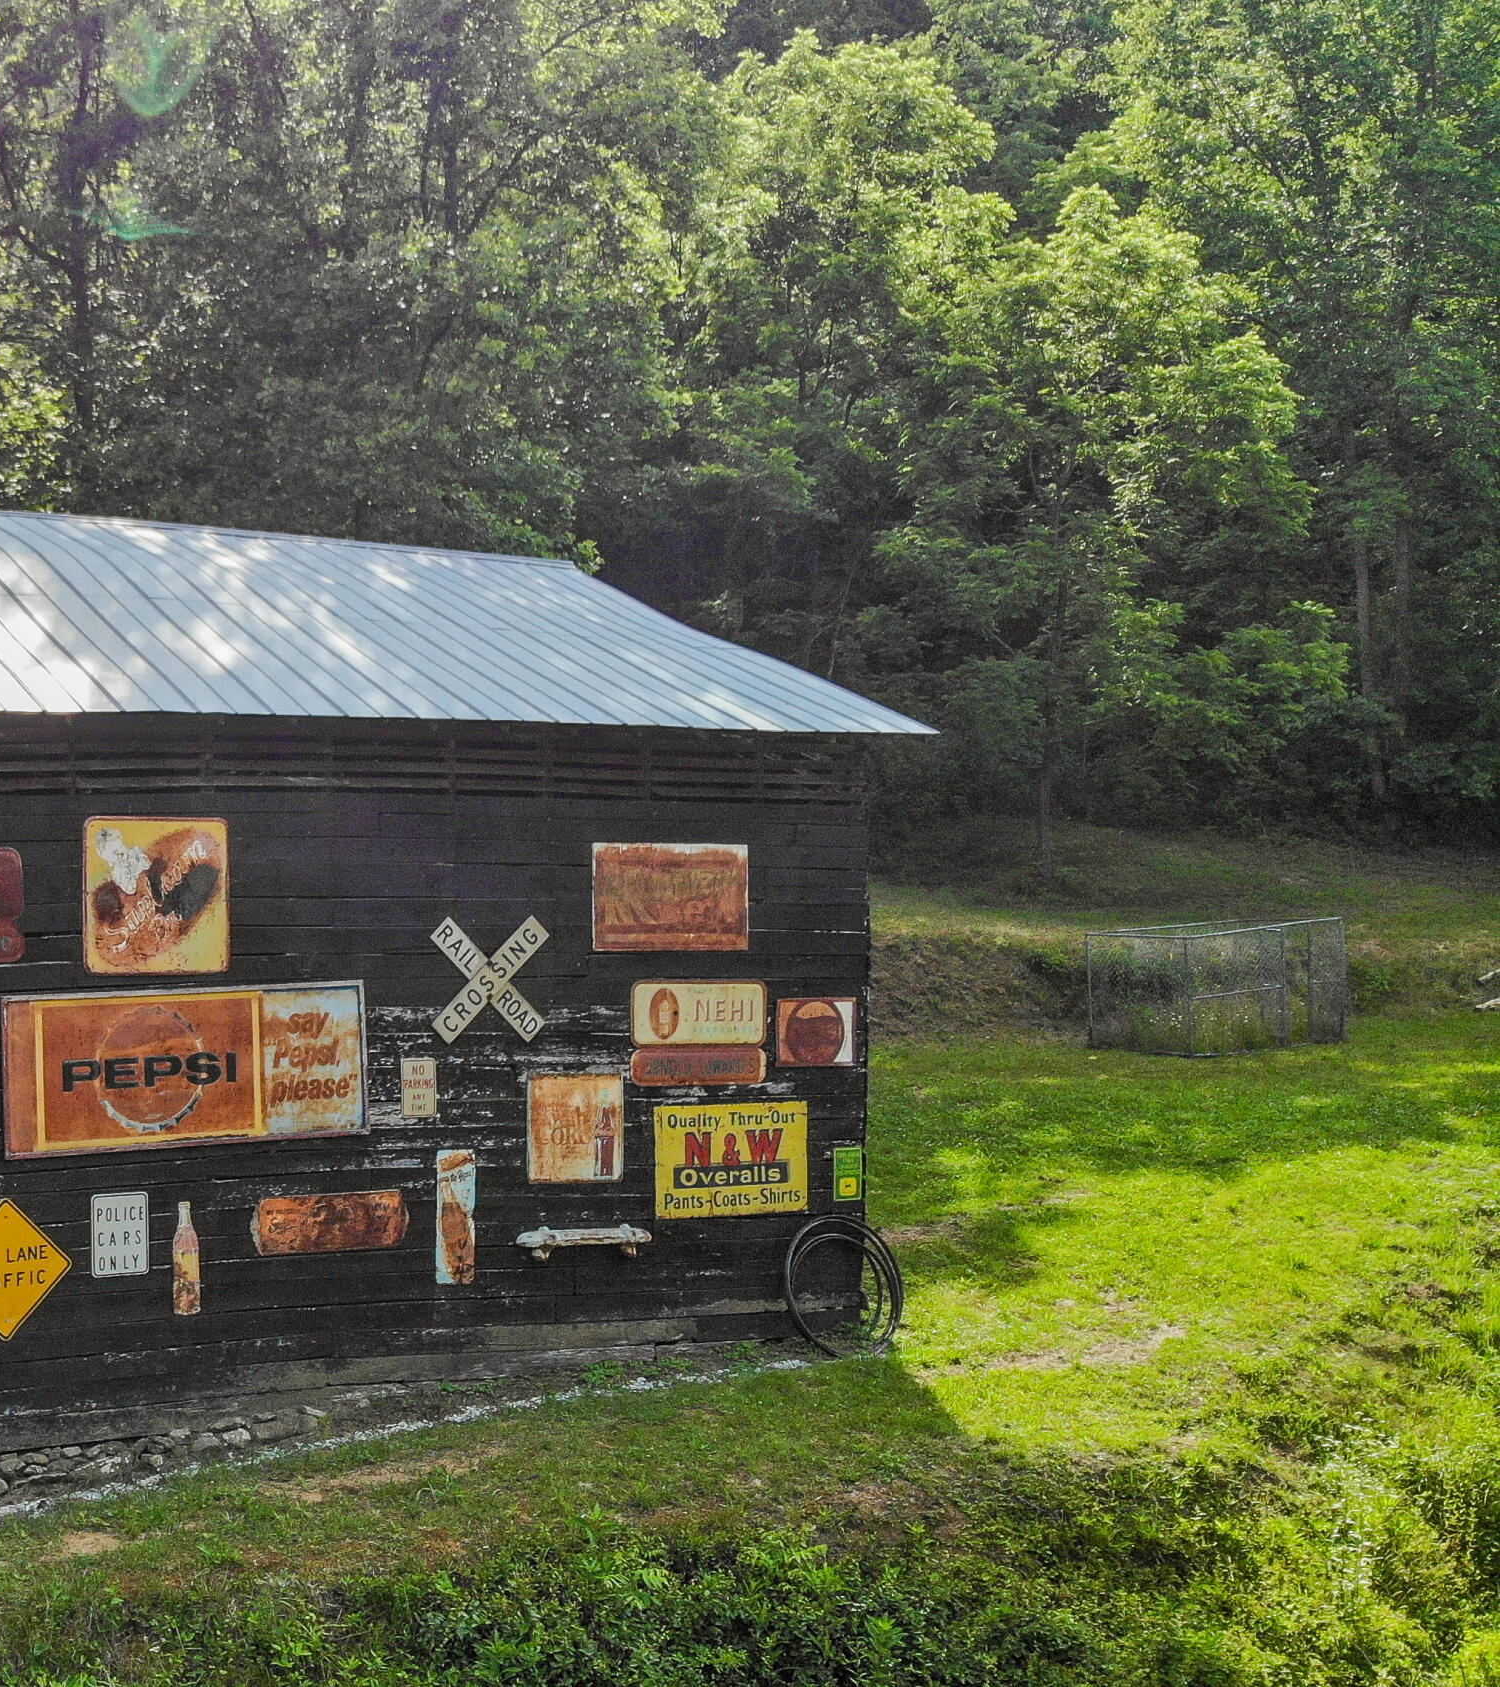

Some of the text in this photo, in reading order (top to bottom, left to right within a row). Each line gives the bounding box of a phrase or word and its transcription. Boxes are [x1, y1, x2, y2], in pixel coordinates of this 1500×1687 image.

[437, 924, 538, 1035] RAIL ROAD
[443, 928, 538, 1033] CROSSING
[693, 998, 755, 1023] NEHI
[287, 1011, 330, 1040] say
[61, 1051, 237, 1093] PEPSI
[412, 1064, 425, 1076] NO
[404, 1078, 434, 1090] PARKING
[667, 1109, 796, 1130] Quality Thru-Out
[684, 1128, 784, 1168] N & W
[680, 1165, 782, 1187] Overalls
[96, 1206, 145, 1222] POLICE
[97, 1229, 142, 1247] CARS
[6, 1244, 48, 1263] LANE
[98, 1254, 139, 1271] ONLY
